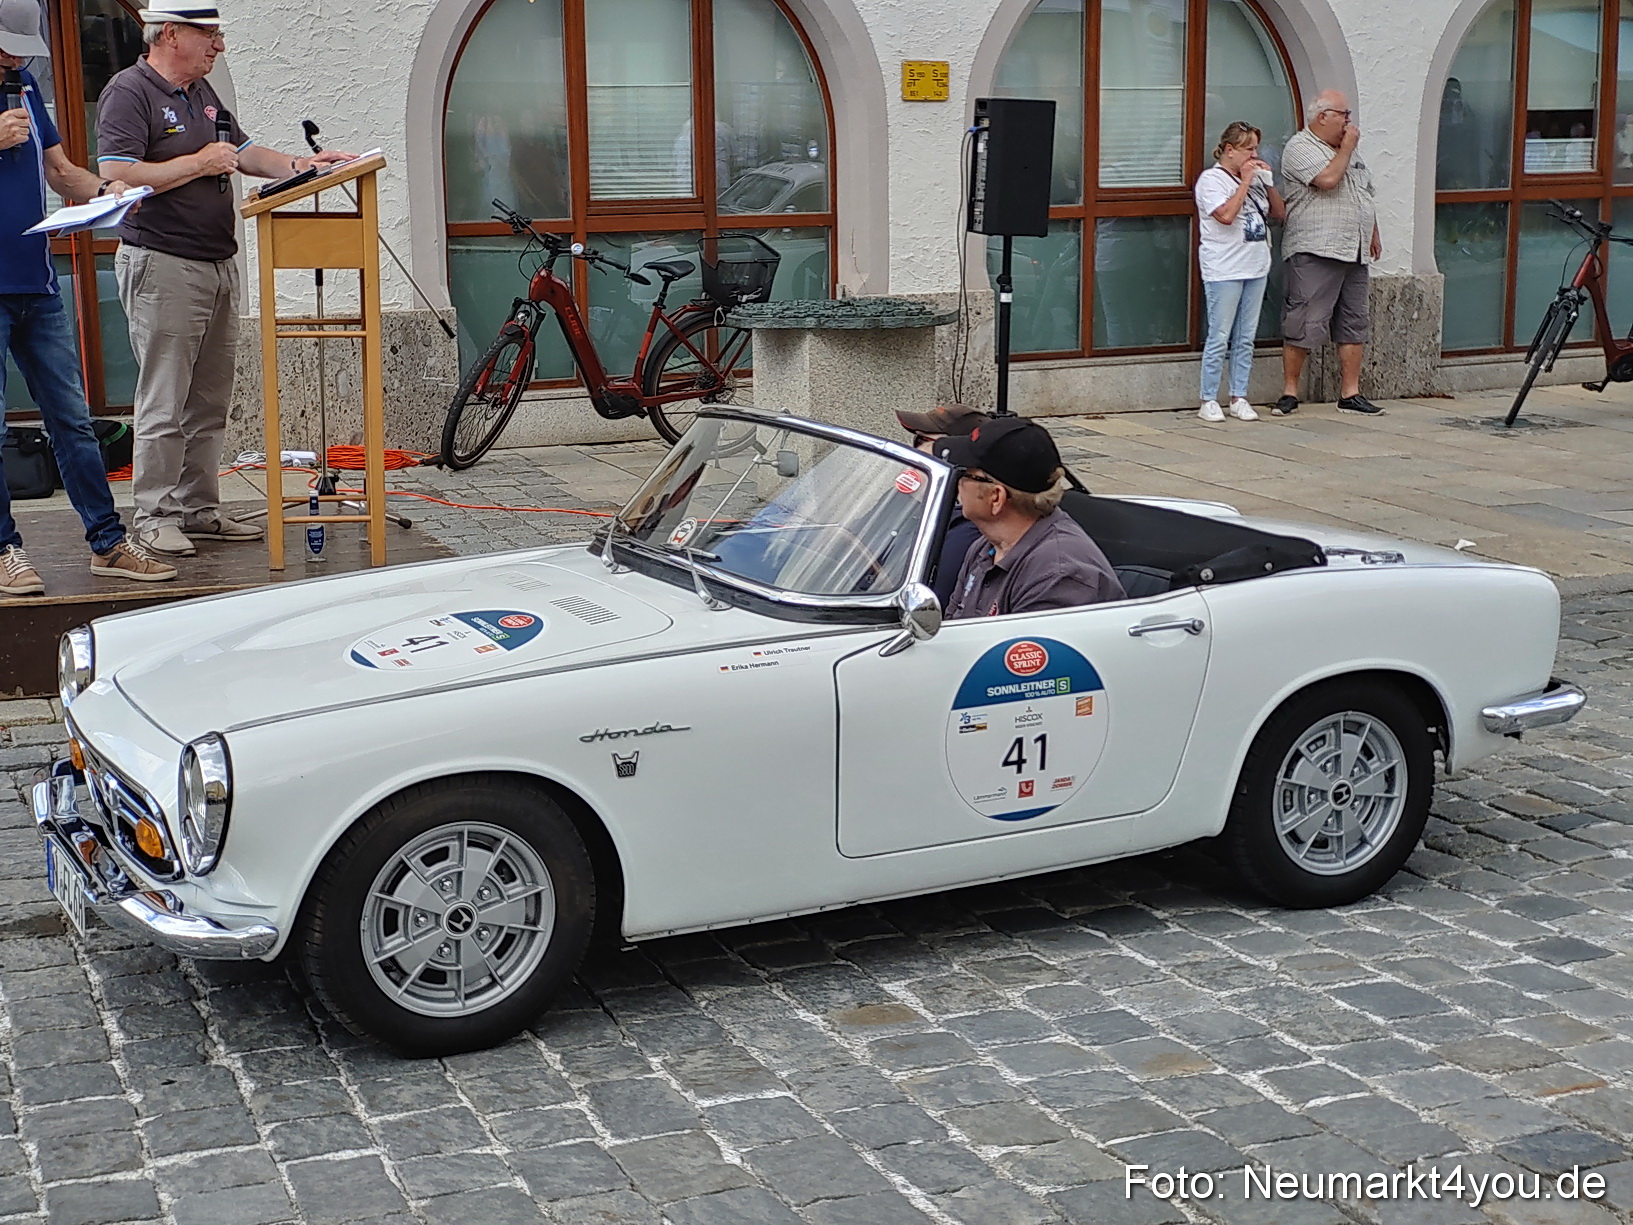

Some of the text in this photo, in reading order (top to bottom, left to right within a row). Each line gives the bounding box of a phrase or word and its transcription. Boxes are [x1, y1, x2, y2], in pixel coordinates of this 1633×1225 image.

[401, 635, 449, 653] 41
[763, 647, 783, 656] Ulrich
[1010, 651, 1043, 662] CLASSIC
[749, 660, 780, 669] Hermann
[1013, 659, 1041, 669] SPRINT
[987, 679, 1067, 697] SONNLEITNER S
[1014, 713, 1043, 724] HISCOX
[579, 721, 692, 743] Honda
[1001, 733, 1047, 775] 41
